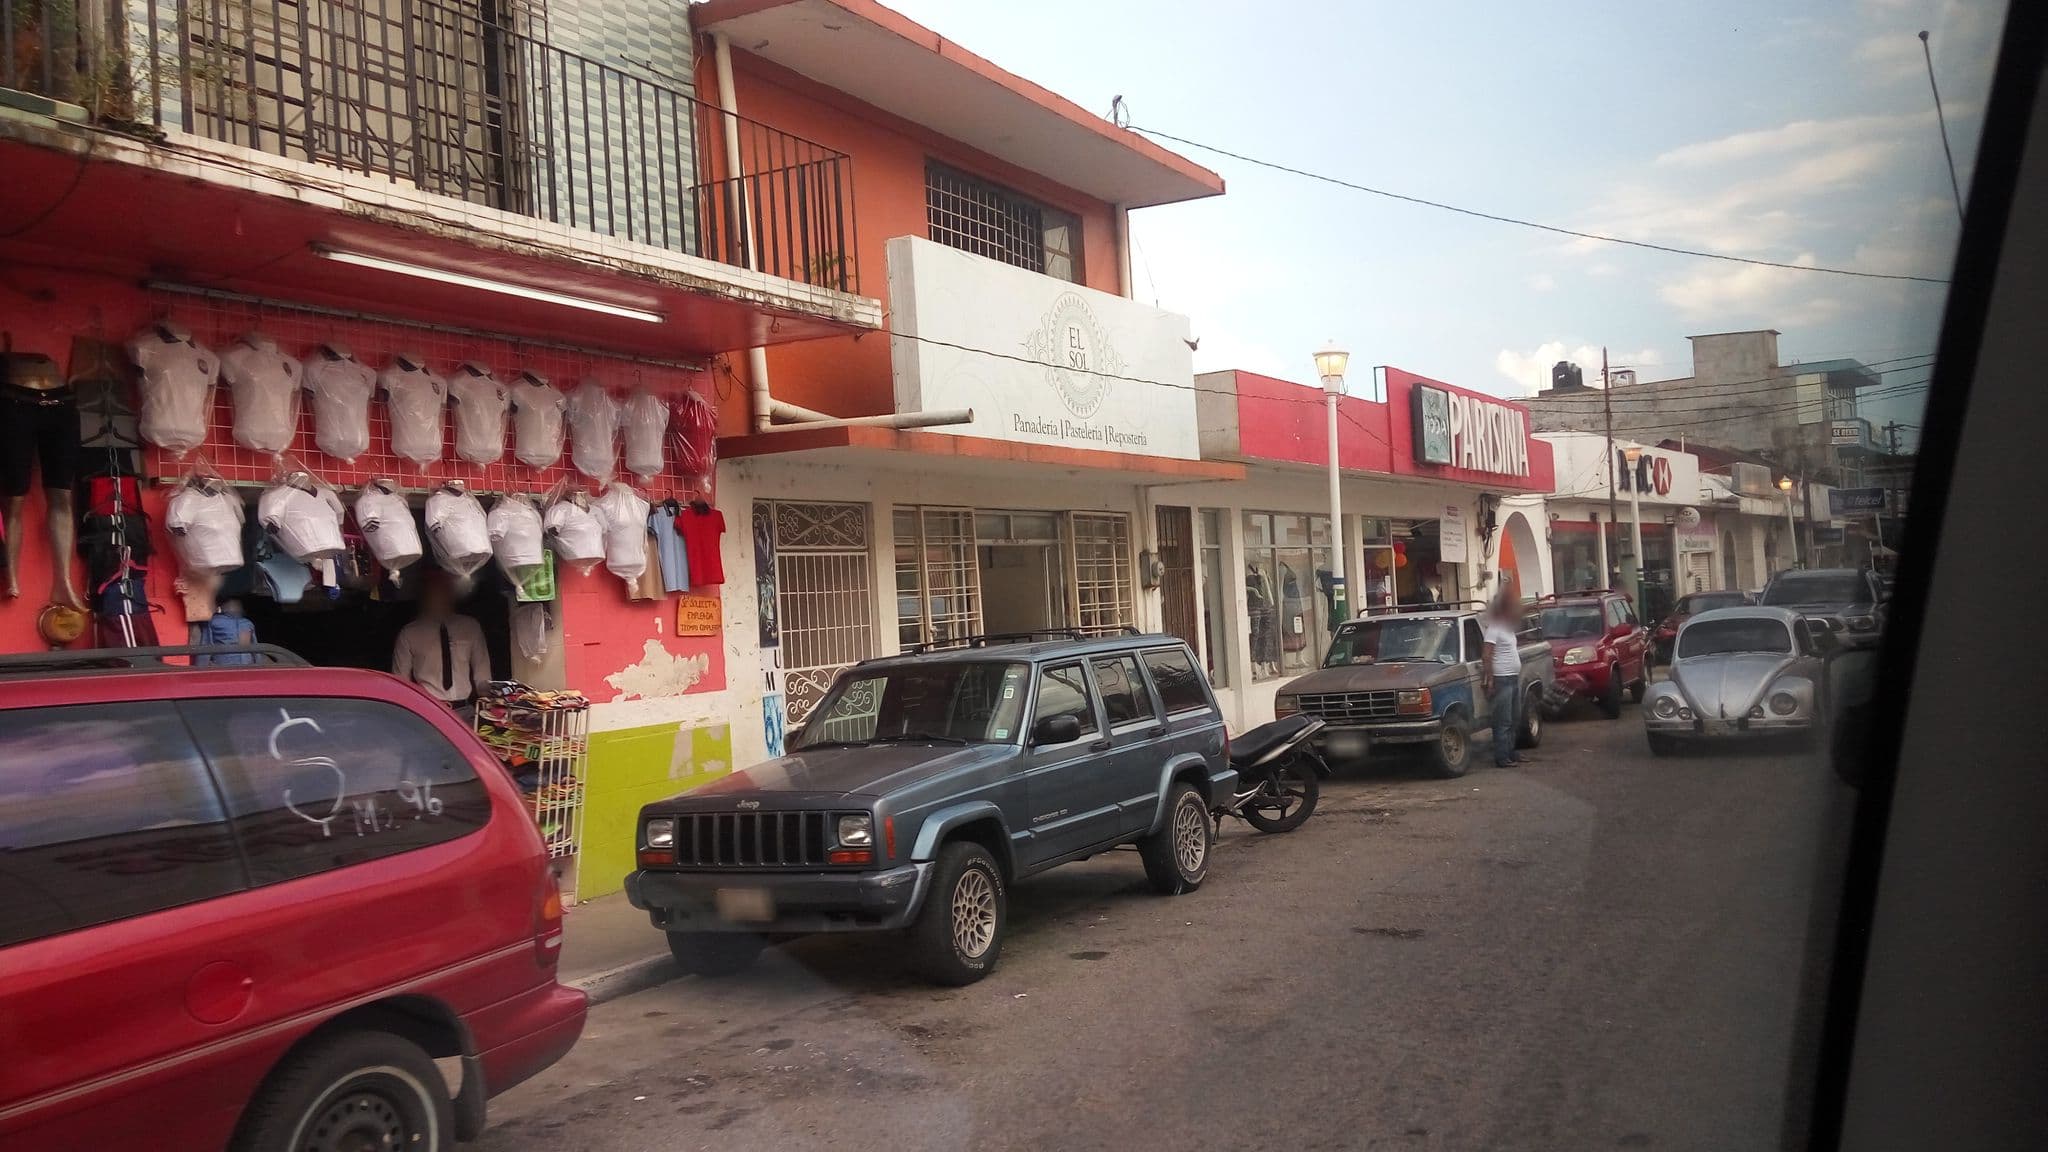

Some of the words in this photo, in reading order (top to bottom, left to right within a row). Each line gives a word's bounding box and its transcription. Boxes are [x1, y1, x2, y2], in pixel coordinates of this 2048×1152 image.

[1068, 327, 1085, 350] EL
[1068, 351, 1090, 371] SOL
[1448, 391, 1530, 478] PARISINA
[736, 799, 760, 810] Jeep
